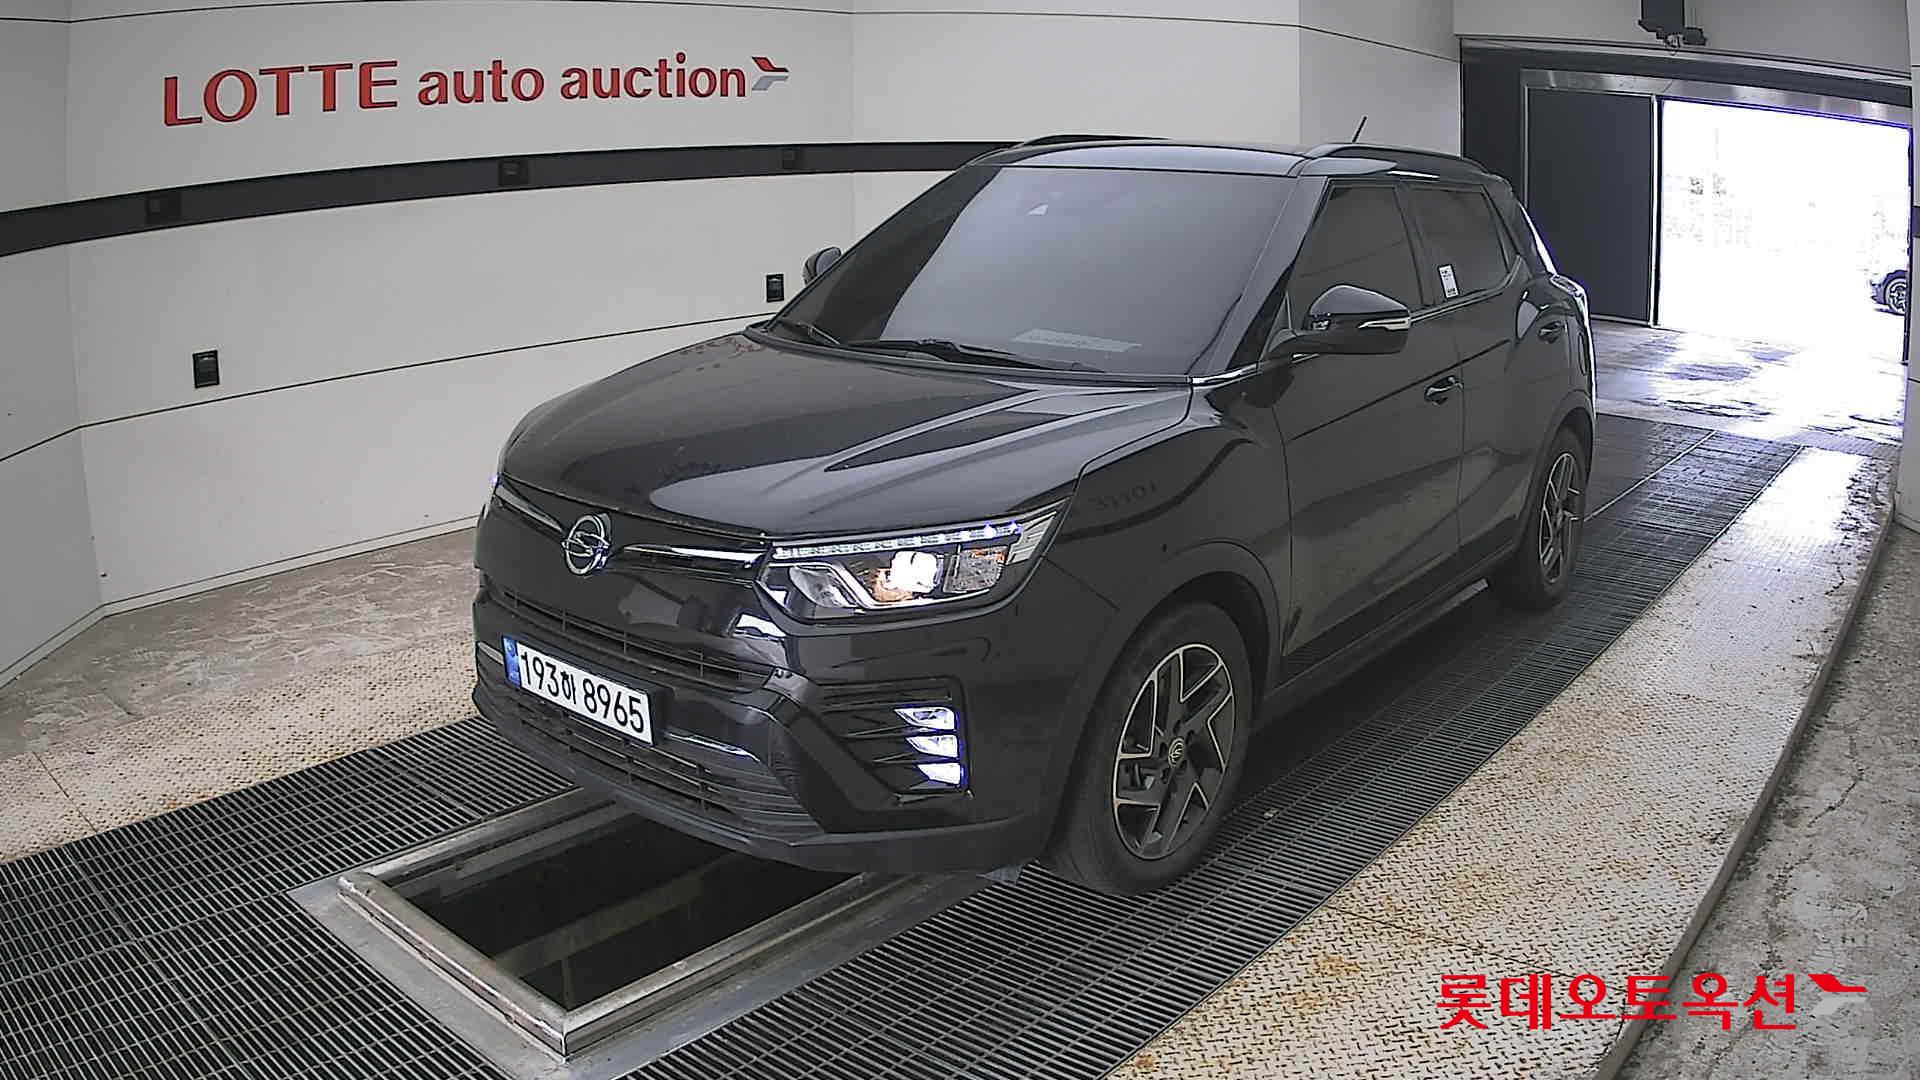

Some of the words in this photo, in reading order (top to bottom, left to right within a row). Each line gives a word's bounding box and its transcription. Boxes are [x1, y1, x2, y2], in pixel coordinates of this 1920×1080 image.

[164, 60, 399, 127] LOTTE
[417, 59, 544, 106] auto
[560, 52, 747, 100] auction
[582, 678, 644, 734] 8965
